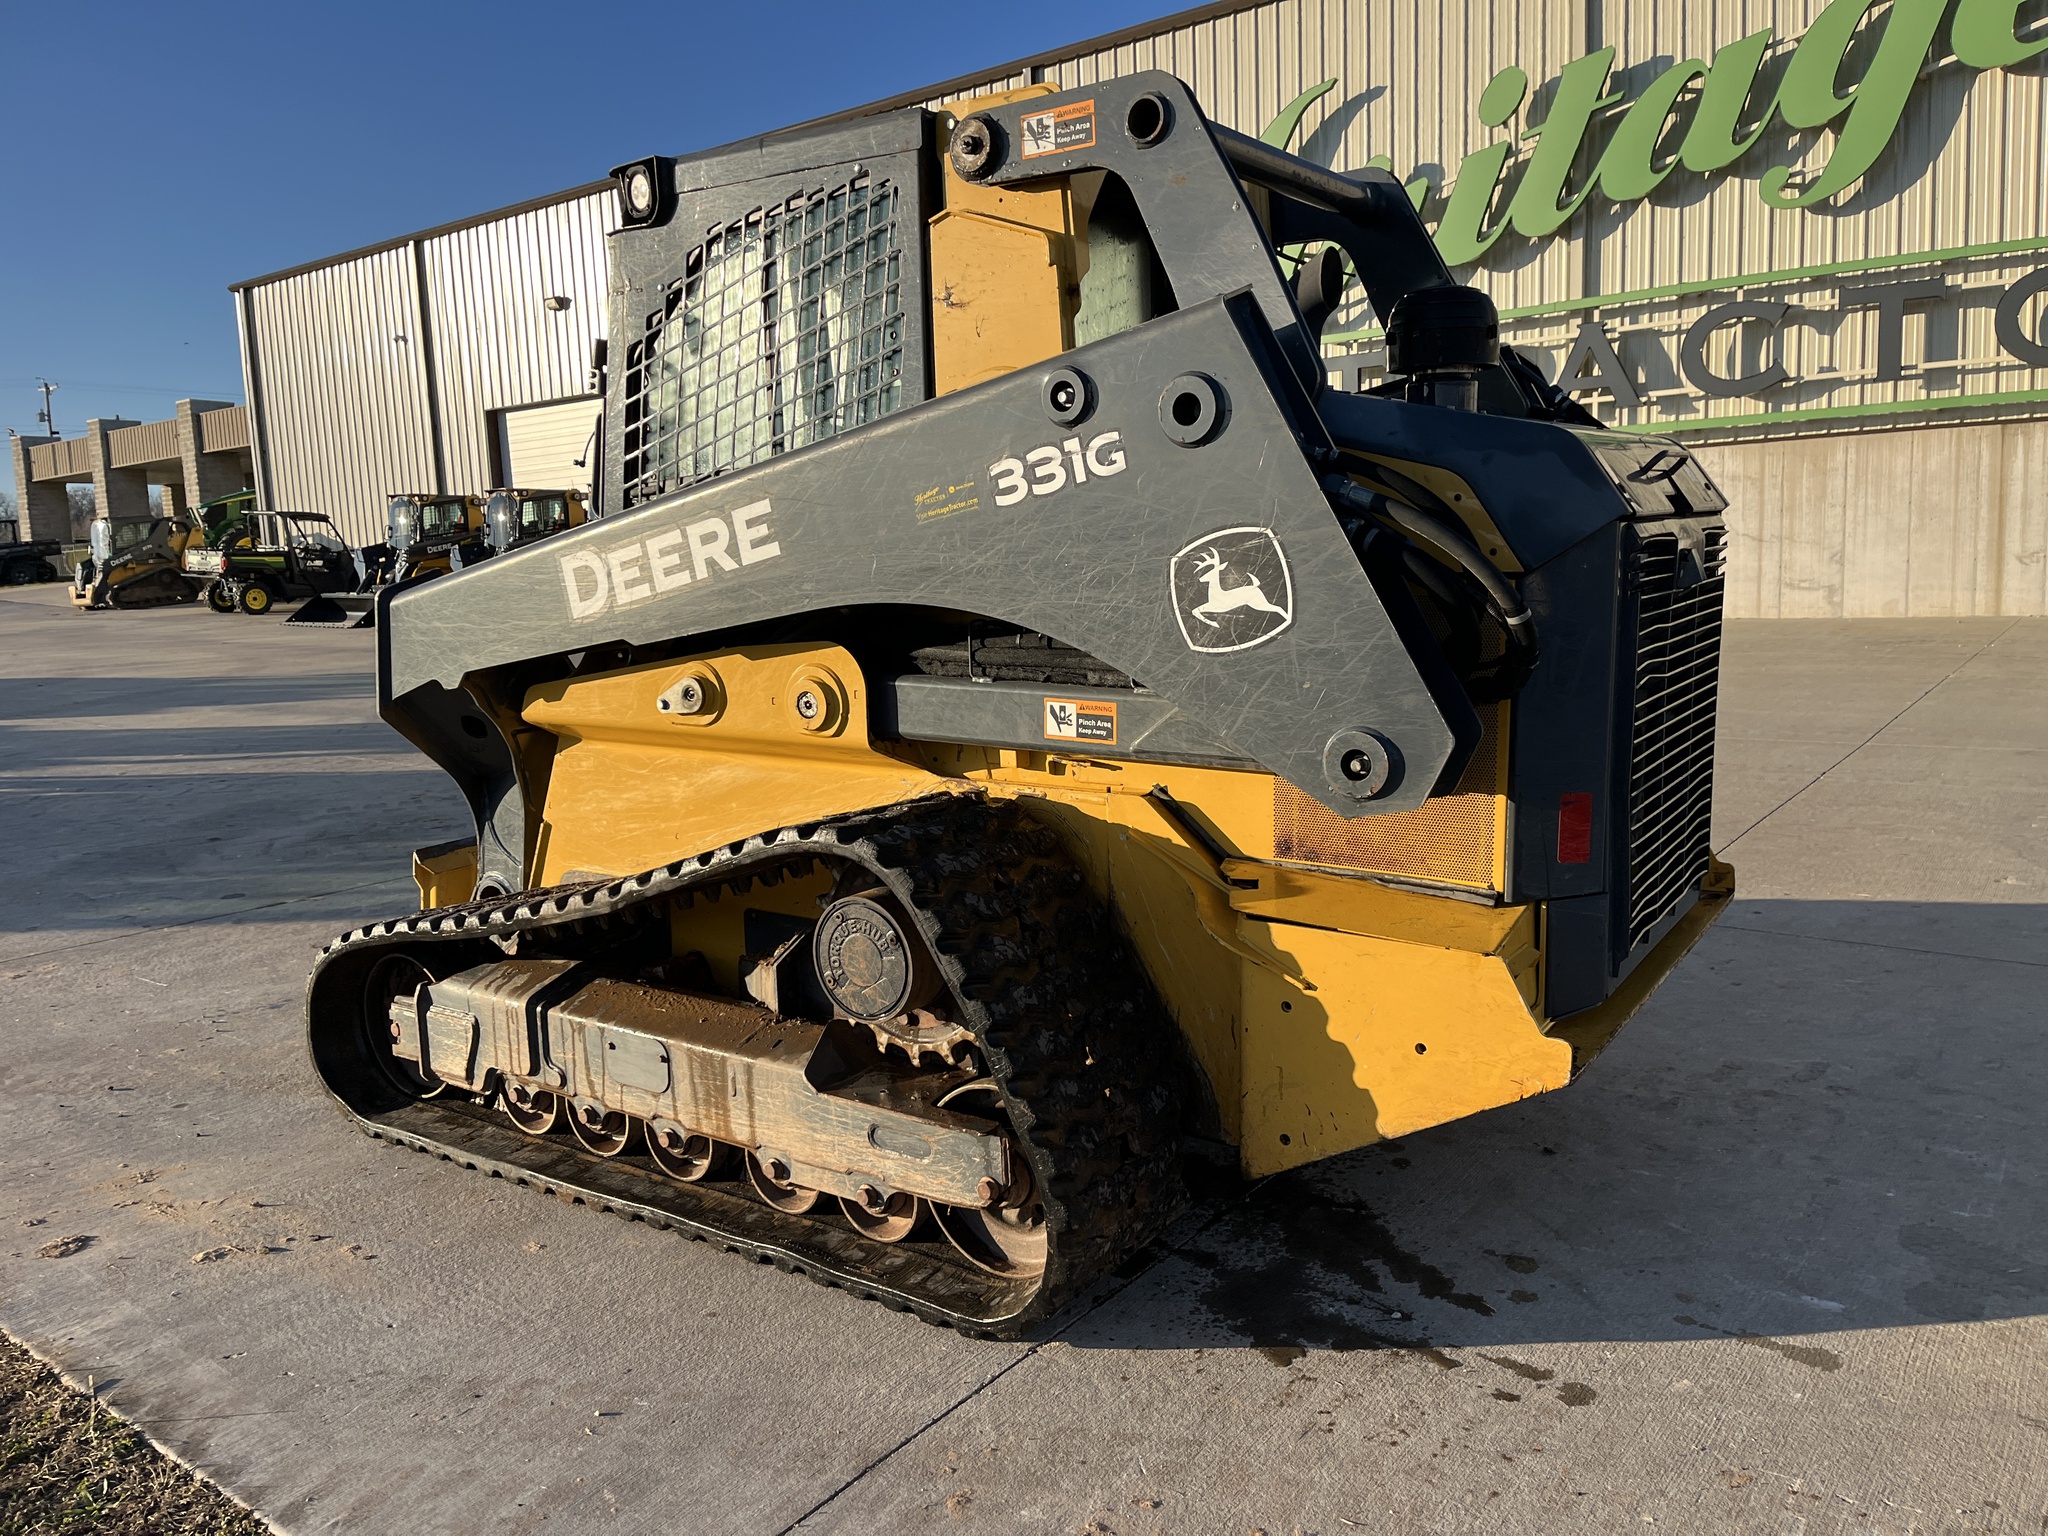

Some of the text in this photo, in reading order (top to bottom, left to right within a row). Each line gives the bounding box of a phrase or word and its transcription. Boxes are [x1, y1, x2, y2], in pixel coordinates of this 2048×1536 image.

[1063, 104, 1091, 116] WARNING
[1075, 122, 1091, 131] Area
[1057, 132, 1087, 144] Keep Away
[989, 431, 1127, 507] 331G
[426, 543, 452, 554] DEERE
[110, 553, 133, 567] DEERE
[559, 498, 782, 620] DEERE
[1085, 705, 1113, 713] WARNING
[1078, 718, 1112, 728] Pinch Area
[1092, 728, 1107, 736] Away
